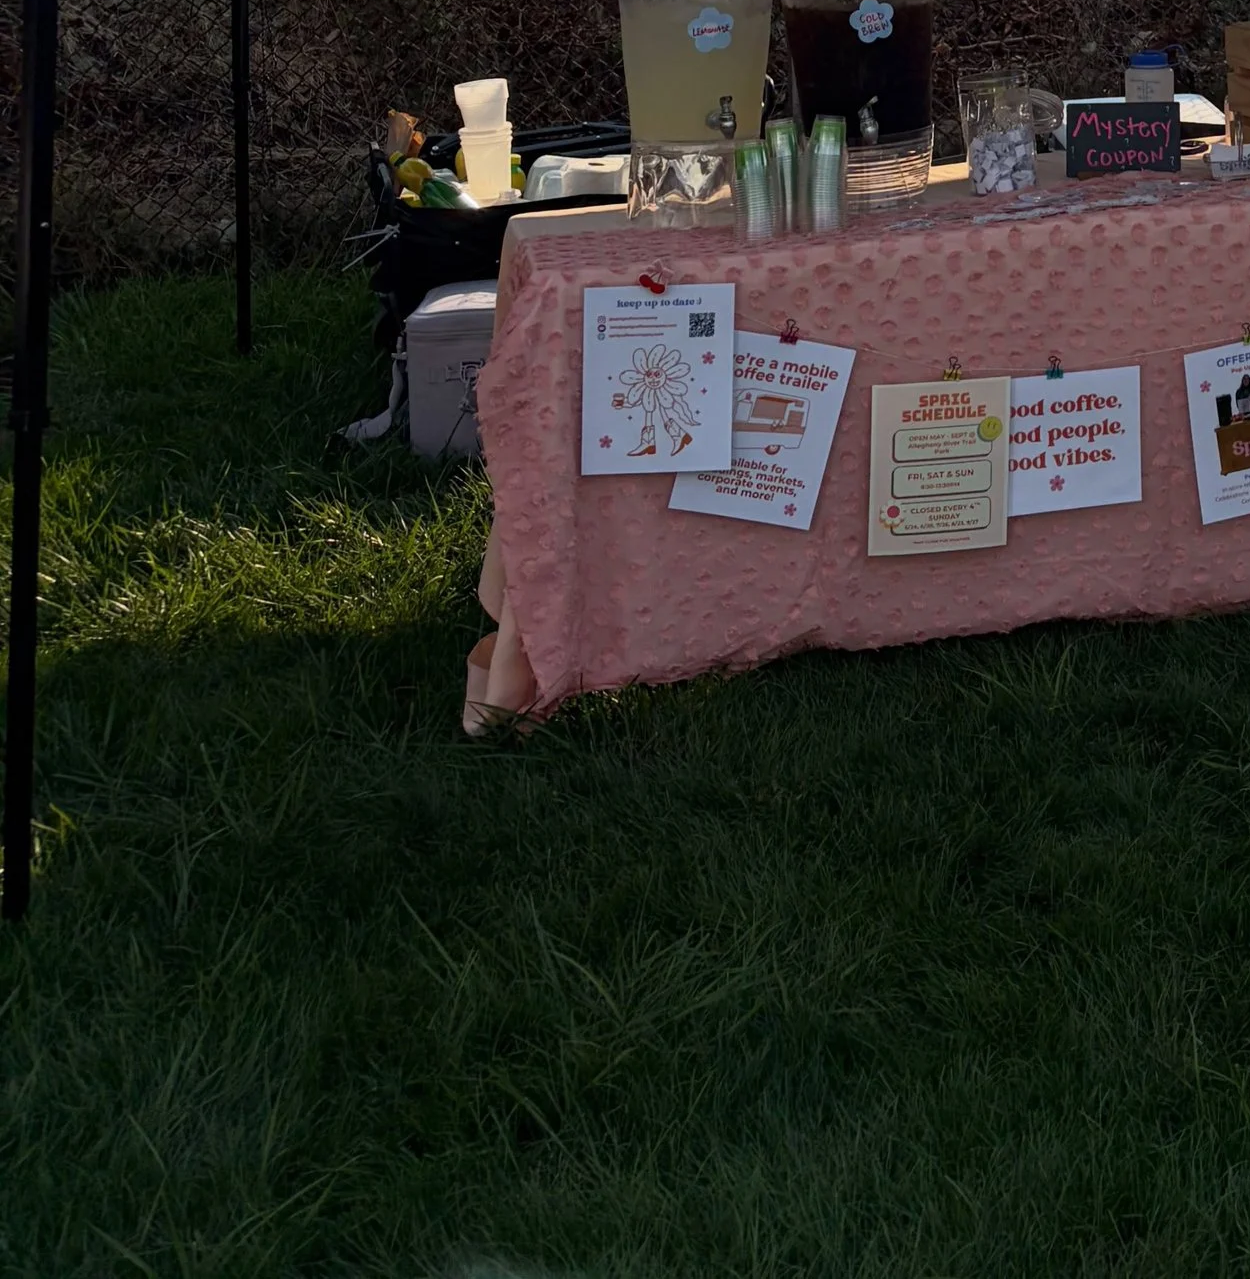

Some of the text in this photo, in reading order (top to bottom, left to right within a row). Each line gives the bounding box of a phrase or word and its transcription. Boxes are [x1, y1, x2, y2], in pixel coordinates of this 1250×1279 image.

[1072, 111, 1172, 147] Mystery
[1087, 146, 1164, 167] COUPON
[616, 299, 642, 310] keep
[644, 300, 658, 309] up
[660, 299, 671, 307] to
[672, 298, 695, 306] date
[733, 352, 839, 380] e're a mobile
[733, 366, 828, 392] offee trailer
[918, 392, 971, 408] SPRIG
[1050, 393, 1122, 414] coffee,
[901, 405, 987, 422] SCHEDULE
[1048, 418, 1126, 447] people,
[731, 458, 788, 474] ailable for
[1008, 447, 1116, 472] ood vibes.
[755, 472, 806, 489] markets,
[926, 471, 945, 479] SAT
[955, 468, 974, 477] SUN
[697, 472, 797, 497] corporate events,
[716, 485, 775, 502] and more!
[910, 505, 942, 515] CLOSED
[942, 503, 967, 513] EVERY
[928, 512, 961, 522] SUNDAY
